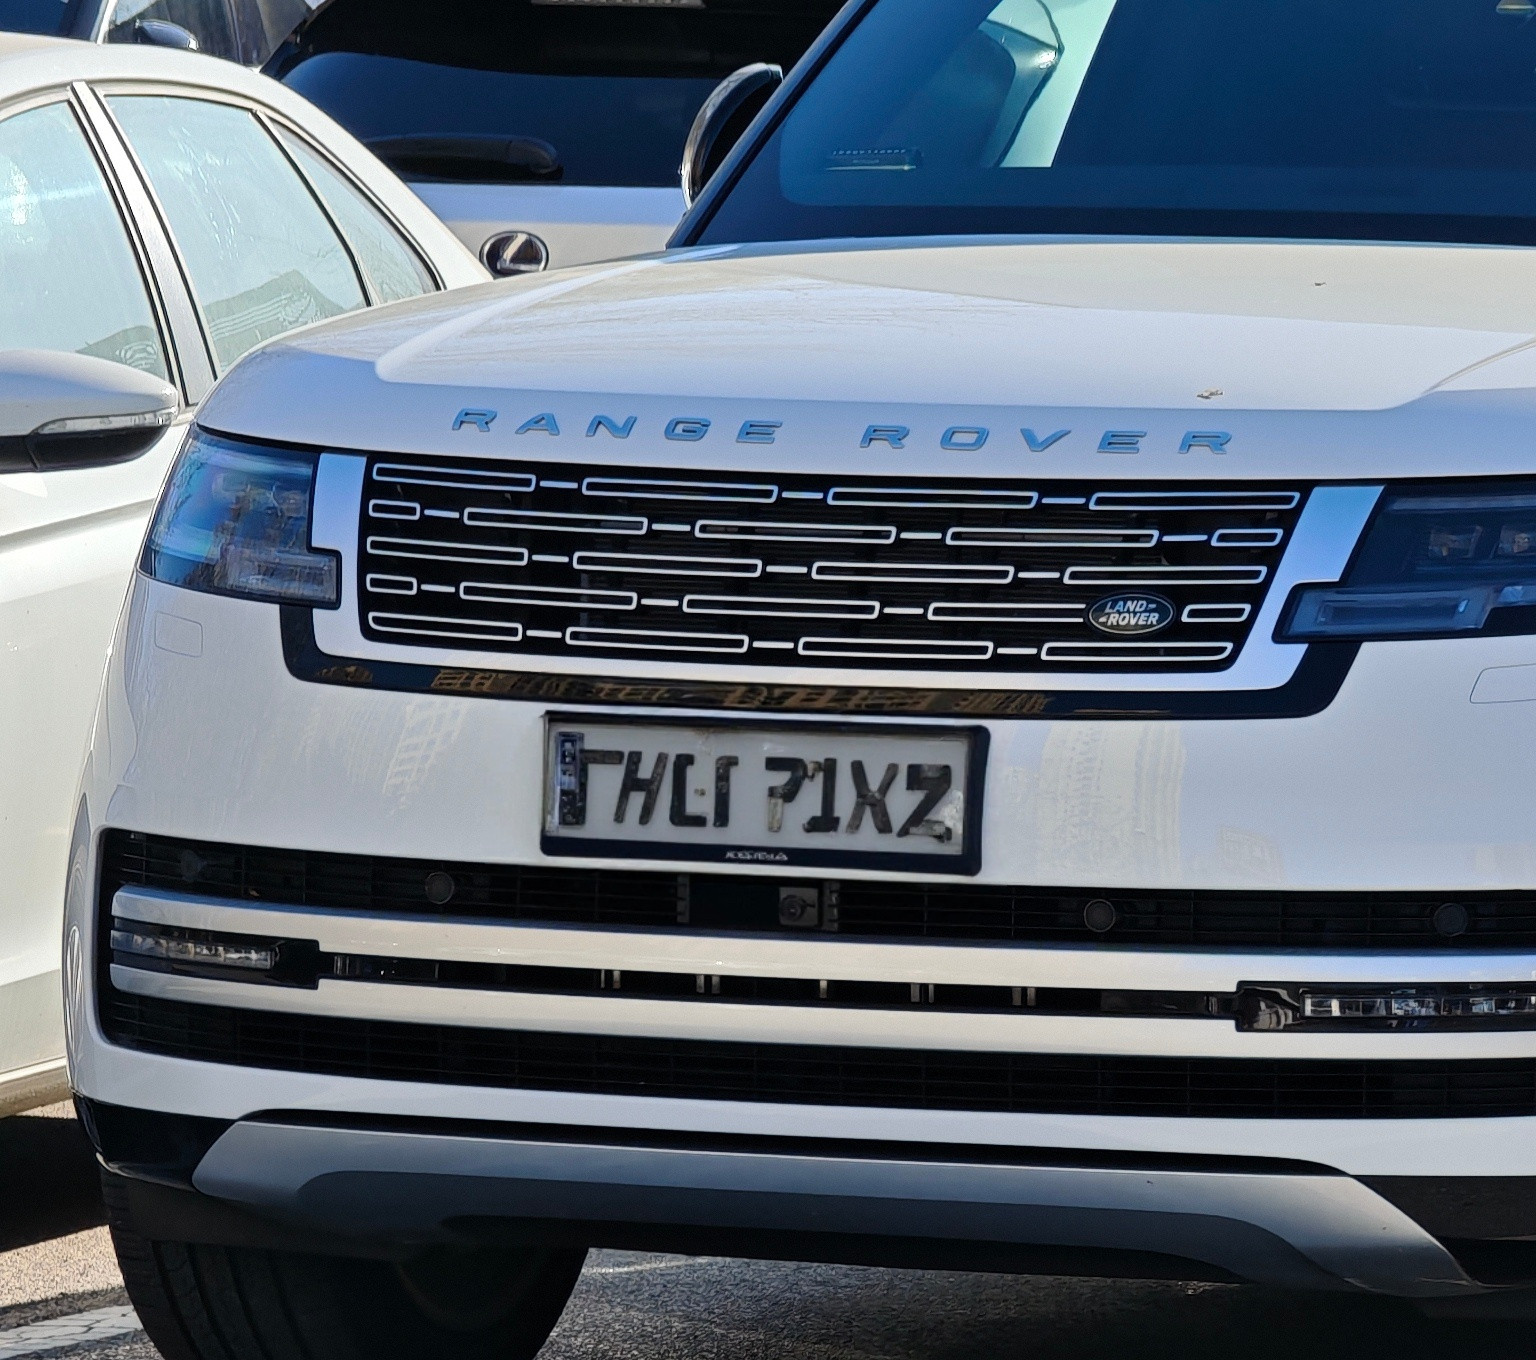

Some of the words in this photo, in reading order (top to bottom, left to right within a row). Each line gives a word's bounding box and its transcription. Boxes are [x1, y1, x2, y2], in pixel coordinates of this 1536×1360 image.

[452, 407, 784, 445] RANGE
[859, 424, 1234, 455] ROVER
[1104, 600, 1147, 613] LAND
[1107, 612, 1159, 626] ROVER
